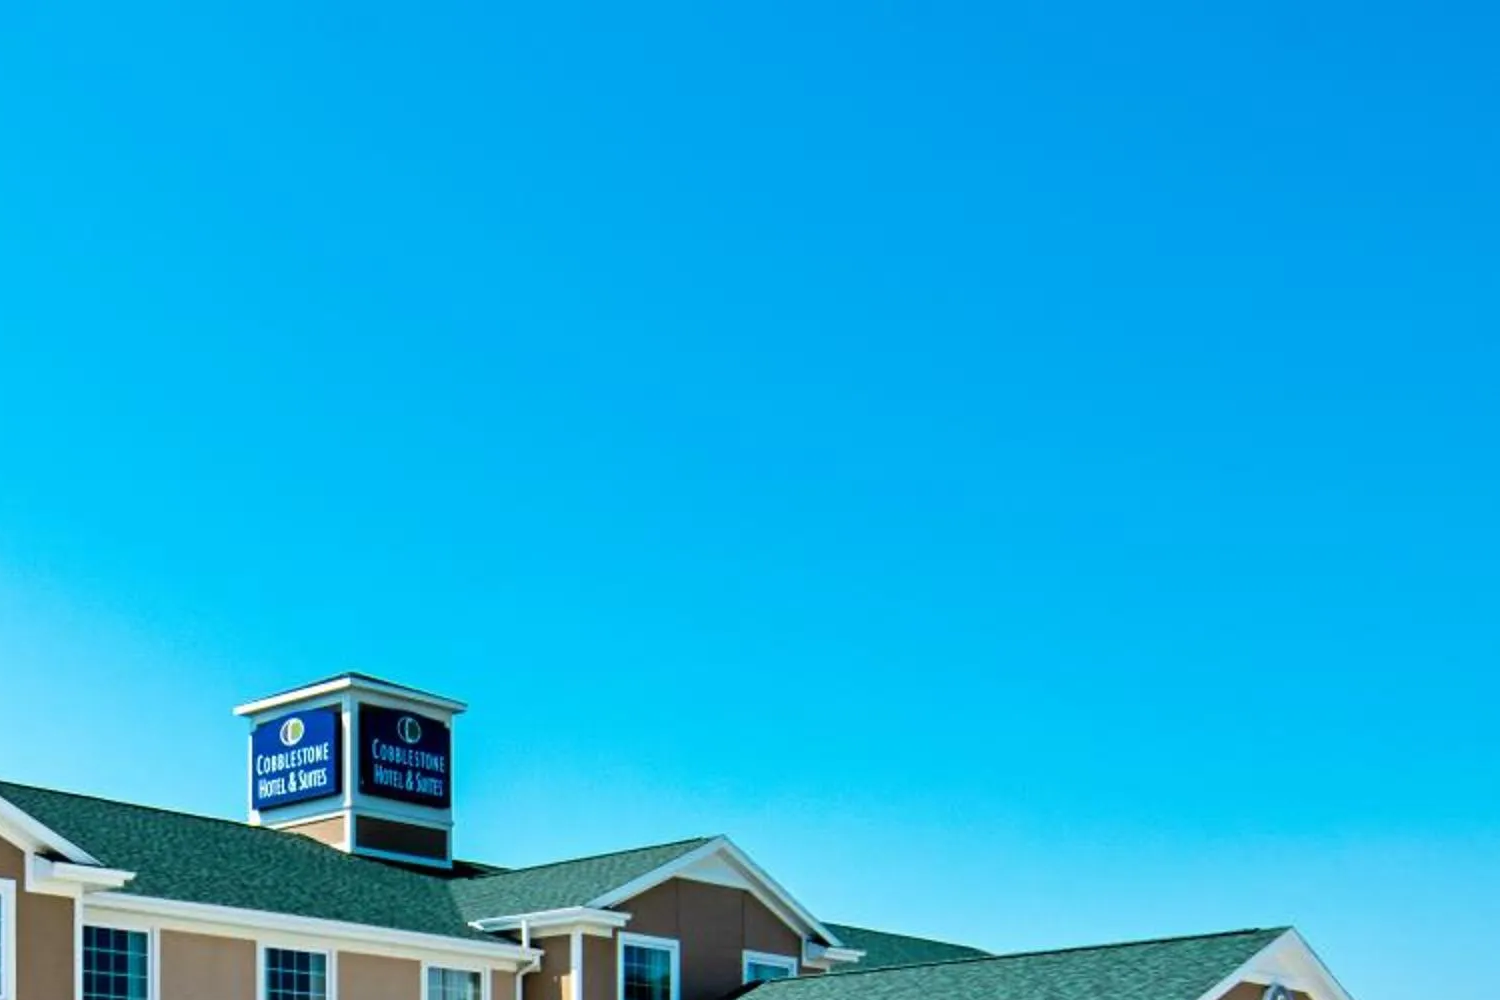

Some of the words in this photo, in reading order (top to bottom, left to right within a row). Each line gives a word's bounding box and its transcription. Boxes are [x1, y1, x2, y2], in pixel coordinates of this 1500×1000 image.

[256, 741, 329, 776] COBBLESTONE
[371, 738, 445, 774] COBBLESTONE
[258, 778, 286, 800] HOTEL
[288, 771, 297, 793] &
[298, 768, 328, 791] SUITES
[373, 764, 404, 790] HOTEL
[405, 769, 414, 792] &
[415, 772, 444, 798] SUITES
